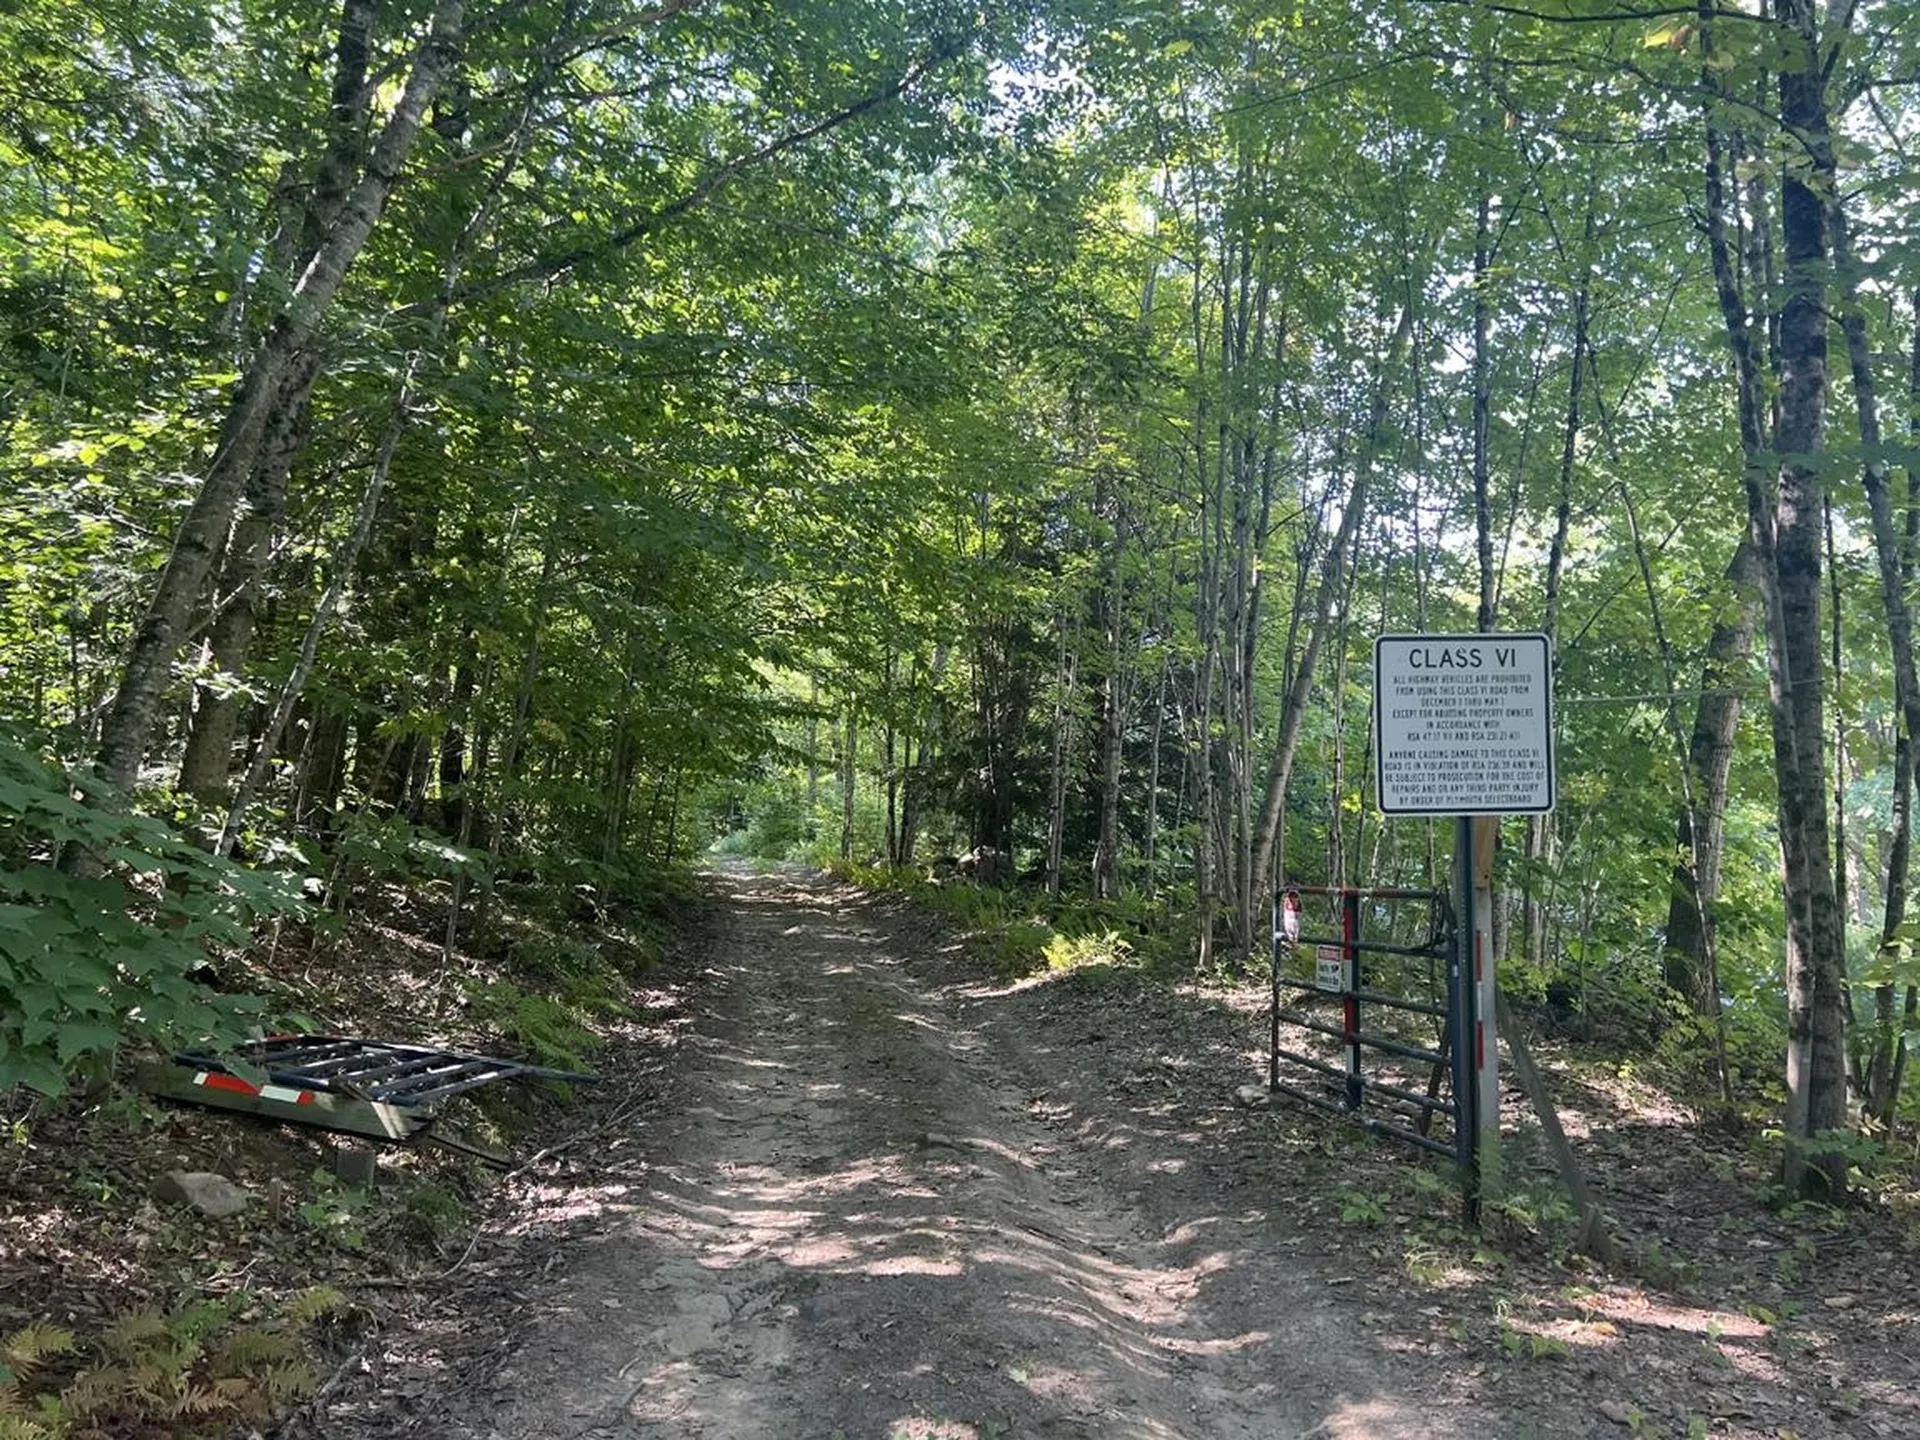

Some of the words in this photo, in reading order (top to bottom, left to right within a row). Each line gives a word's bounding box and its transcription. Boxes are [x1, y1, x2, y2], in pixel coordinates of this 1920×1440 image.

[1409, 648, 1482, 668] CLASS
[1496, 647, 1516, 667] VI
[1394, 675, 1406, 684] ALL
[1408, 675, 1439, 684] HIGHWAY
[1441, 675, 1473, 684] VEHICLES
[1475, 674, 1488, 683] ARE
[1491, 674, 1532, 683] PROHIBITED
[1396, 687, 1414, 696] FROM
[1417, 687, 1438, 696] USING
[1440, 686, 1455, 696] THIS
[1457, 686, 1478, 695] CLASS
[1481, 686, 1488, 695] VI
[1490, 686, 1508, 695] ROAD
[1511, 685, 1529, 694] FROM
[1421, 697, 1456, 707] DECEMBER
[1392, 709, 1417, 719] EXCEPT
[1419, 709, 1433, 718] FOR
[1469, 709, 1503, 718] PROPERTY
[1506, 708, 1534, 717] OWNERS
[1426, 721, 1434, 730] IN
[1436, 721, 1480, 730] ACCORDANCE
[1484, 720, 1500, 730] WITH
[1408, 732, 1420, 741] RSA
[1455, 732, 1469, 741] AND
[1471, 732, 1485, 741] RSA
[1389, 751, 1416, 760] ANYONE
[1418, 750, 1448, 760] CAUSING
[1451, 749, 1478, 759] DAMAGE
[1480, 749, 1489, 759] TO
[1491, 749, 1506, 758] THIS
[1508, 748, 1530, 758] CLASS
[1532, 748, 1539, 758] VI
[1384, 762, 1402, 771] ROAD
[1414, 762, 1421, 770] IN
[1423, 761, 1459, 770] VIOLATION
[1461, 761, 1470, 770] OF
[1472, 761, 1485, 770] RSA
[1512, 760, 1527, 769] AND
[1529, 760, 1545, 769] WILL
[1385, 773, 1393, 782] BE
[1396, 773, 1426, 782] SUBJECT
[1428, 773, 1436, 782] TO
[1438, 772, 1484, 782] PROSECUTION
[1486, 772, 1500, 781] FOR
[1502, 771, 1514, 781] THE
[1516, 771, 1534, 780] COST
[1535, 770, 1545, 780] OF
[1391, 785, 1420, 794] REPAIRS
[1422, 784, 1436, 794] AND
[1450, 784, 1464, 793] ANY
[1489, 783, 1510, 792] PARTY
[1399, 797, 1408, 806] BY
[1411, 796, 1433, 805] ORDER
[1435, 796, 1444, 805] OF
